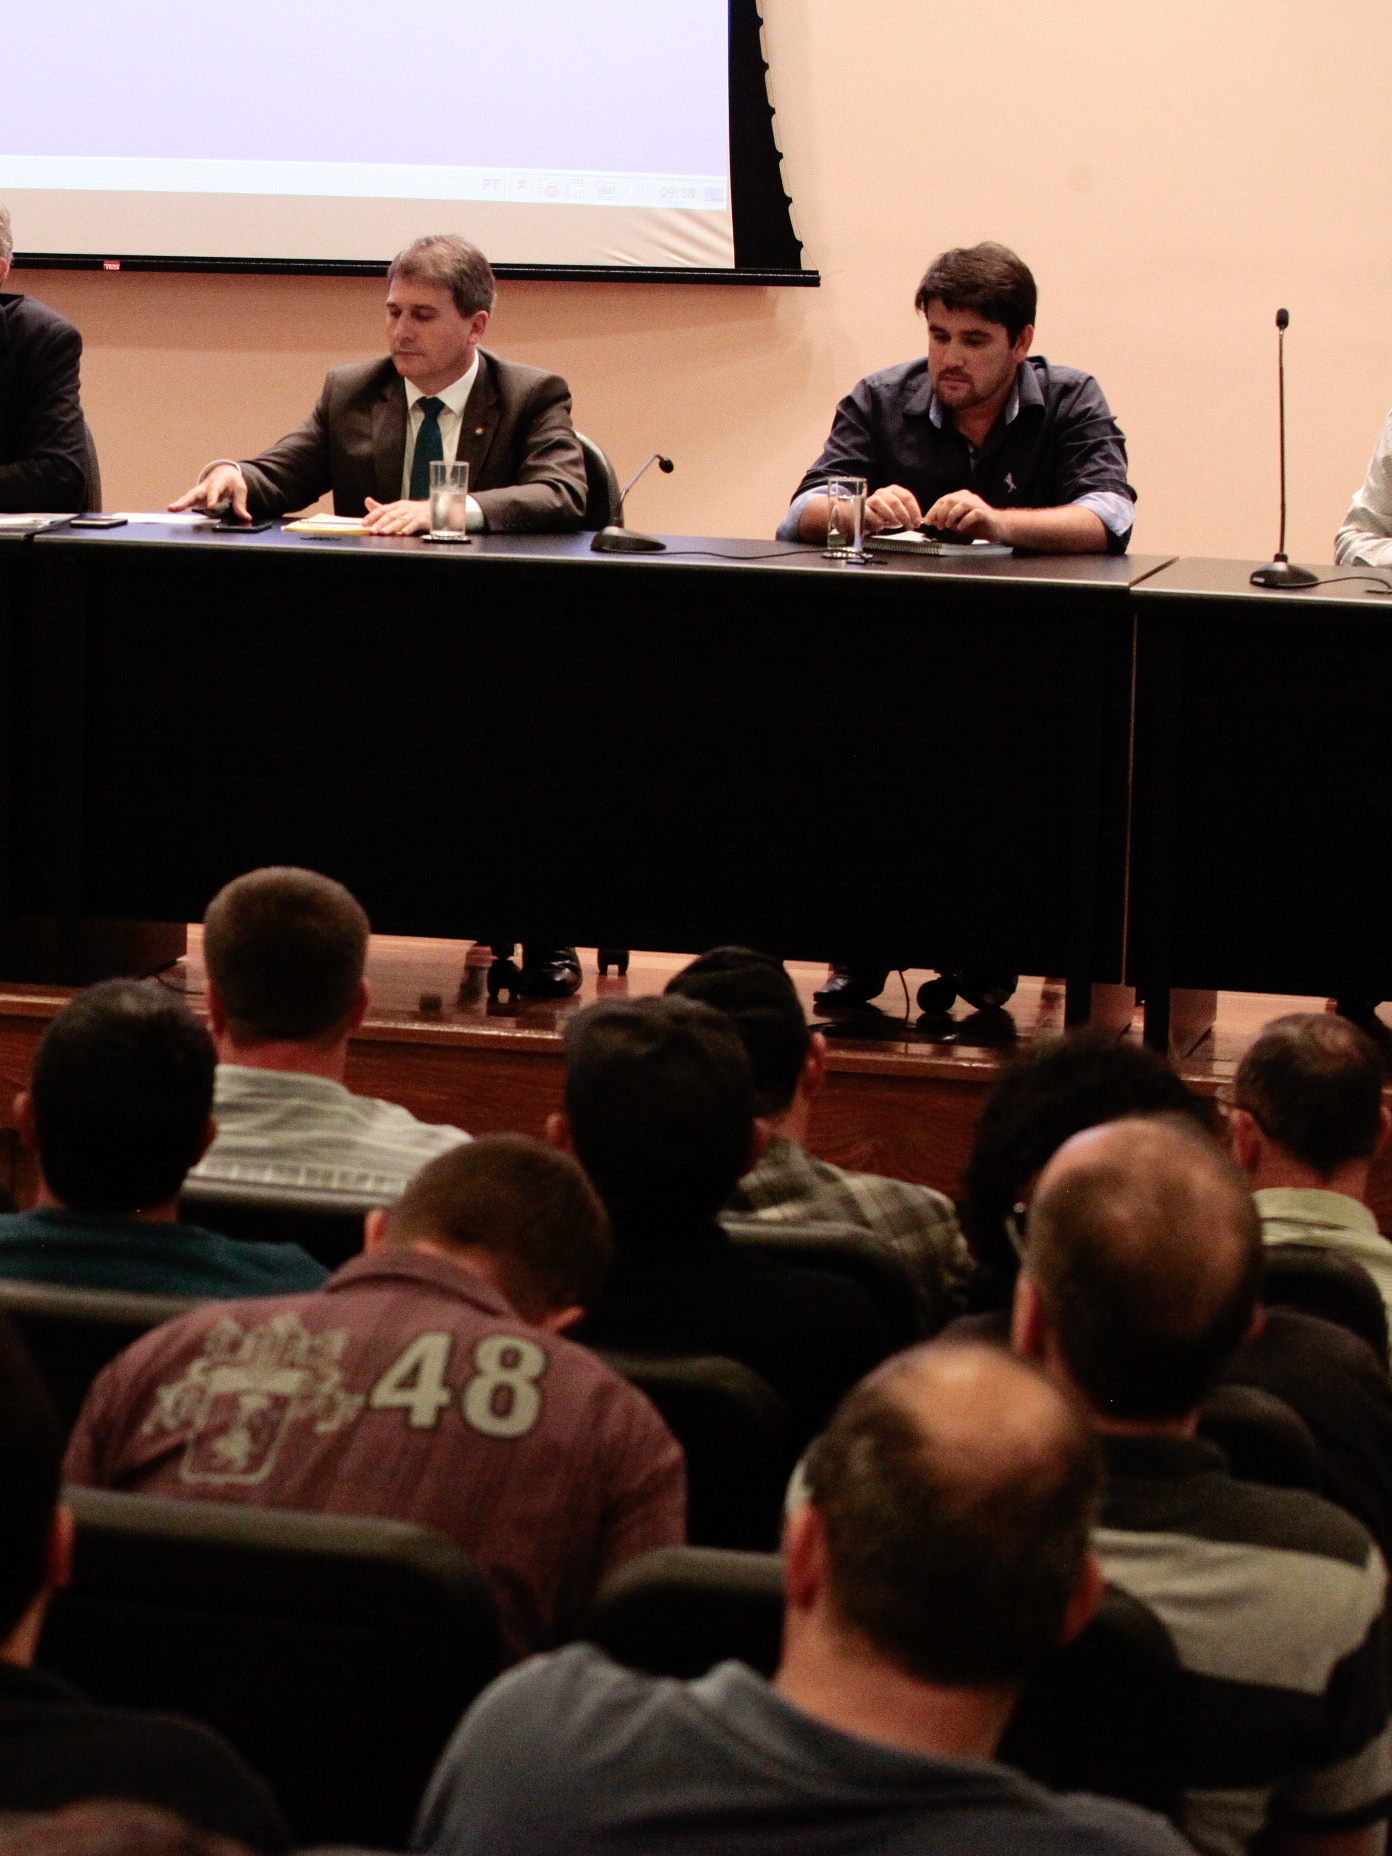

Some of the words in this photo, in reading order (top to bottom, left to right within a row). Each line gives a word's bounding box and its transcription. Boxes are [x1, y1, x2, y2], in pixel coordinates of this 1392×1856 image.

[482, 179, 499, 191] PT
[660, 187, 695, 199] 09:58
[370, 1331, 546, 1438] 48
